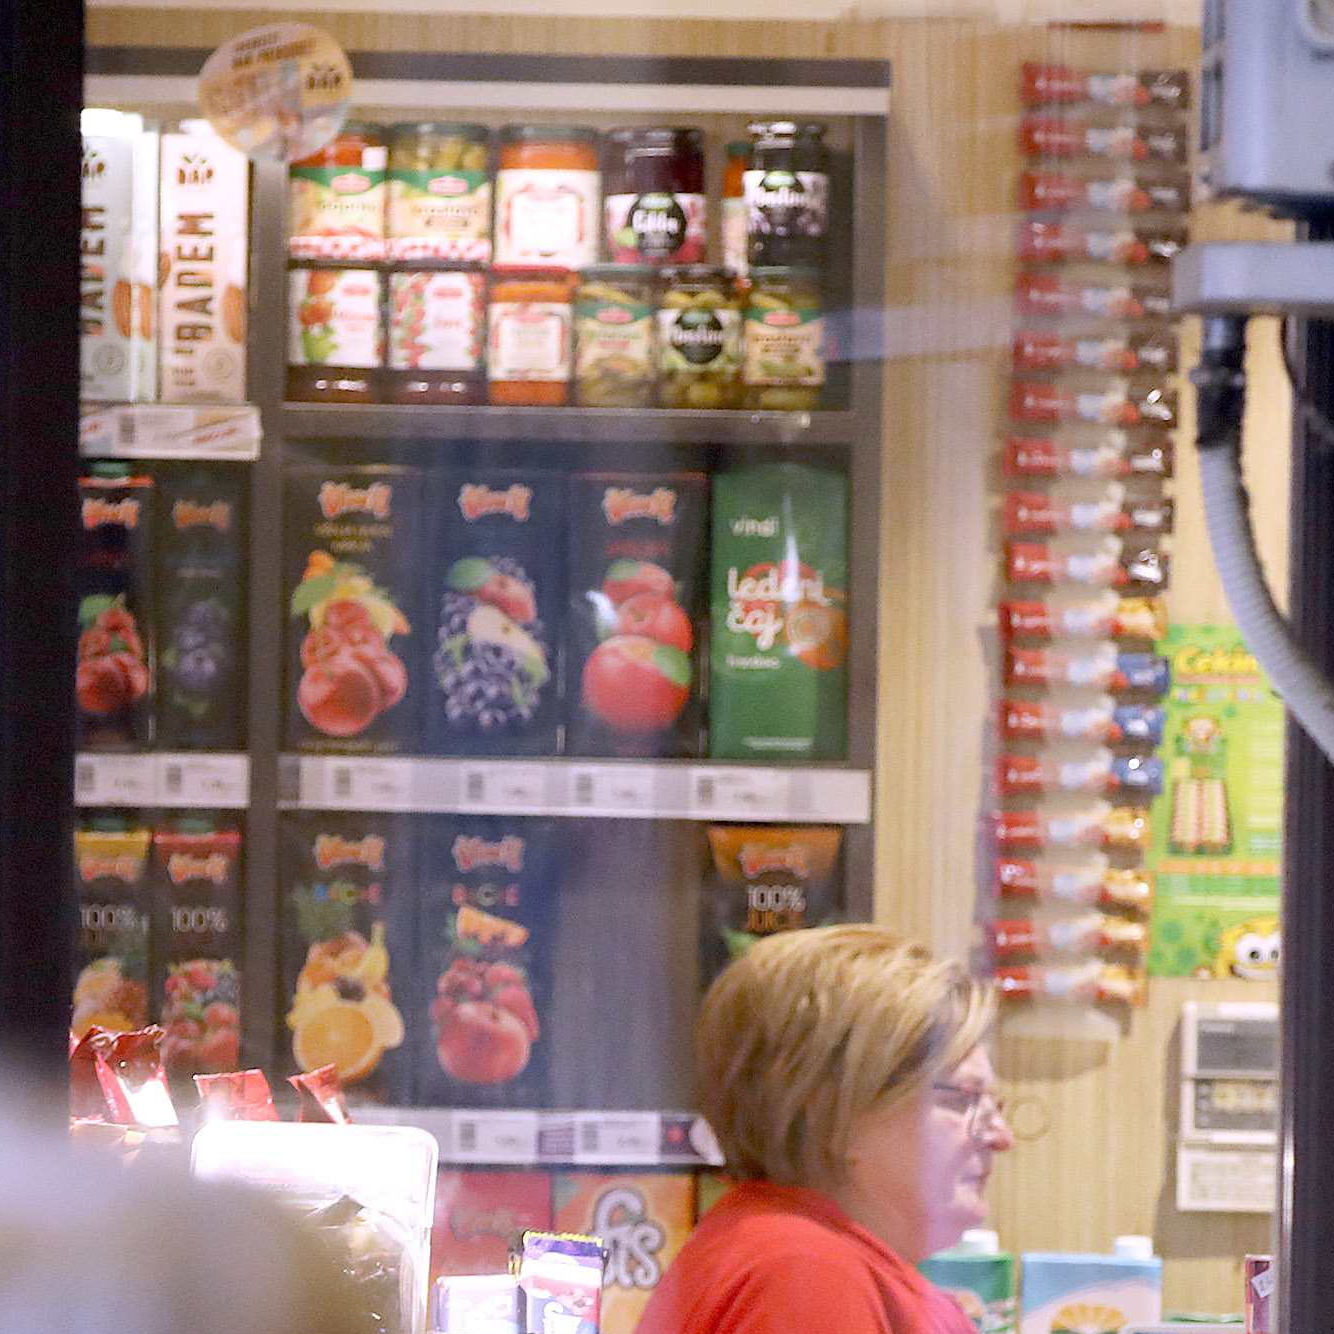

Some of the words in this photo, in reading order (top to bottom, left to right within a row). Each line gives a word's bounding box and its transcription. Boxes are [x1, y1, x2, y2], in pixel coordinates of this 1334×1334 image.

[175, 212, 215, 342] BADEM
[748, 885, 807, 912] 100%
[80, 905, 137, 932] 100%
[171, 906, 229, 933] 100%
